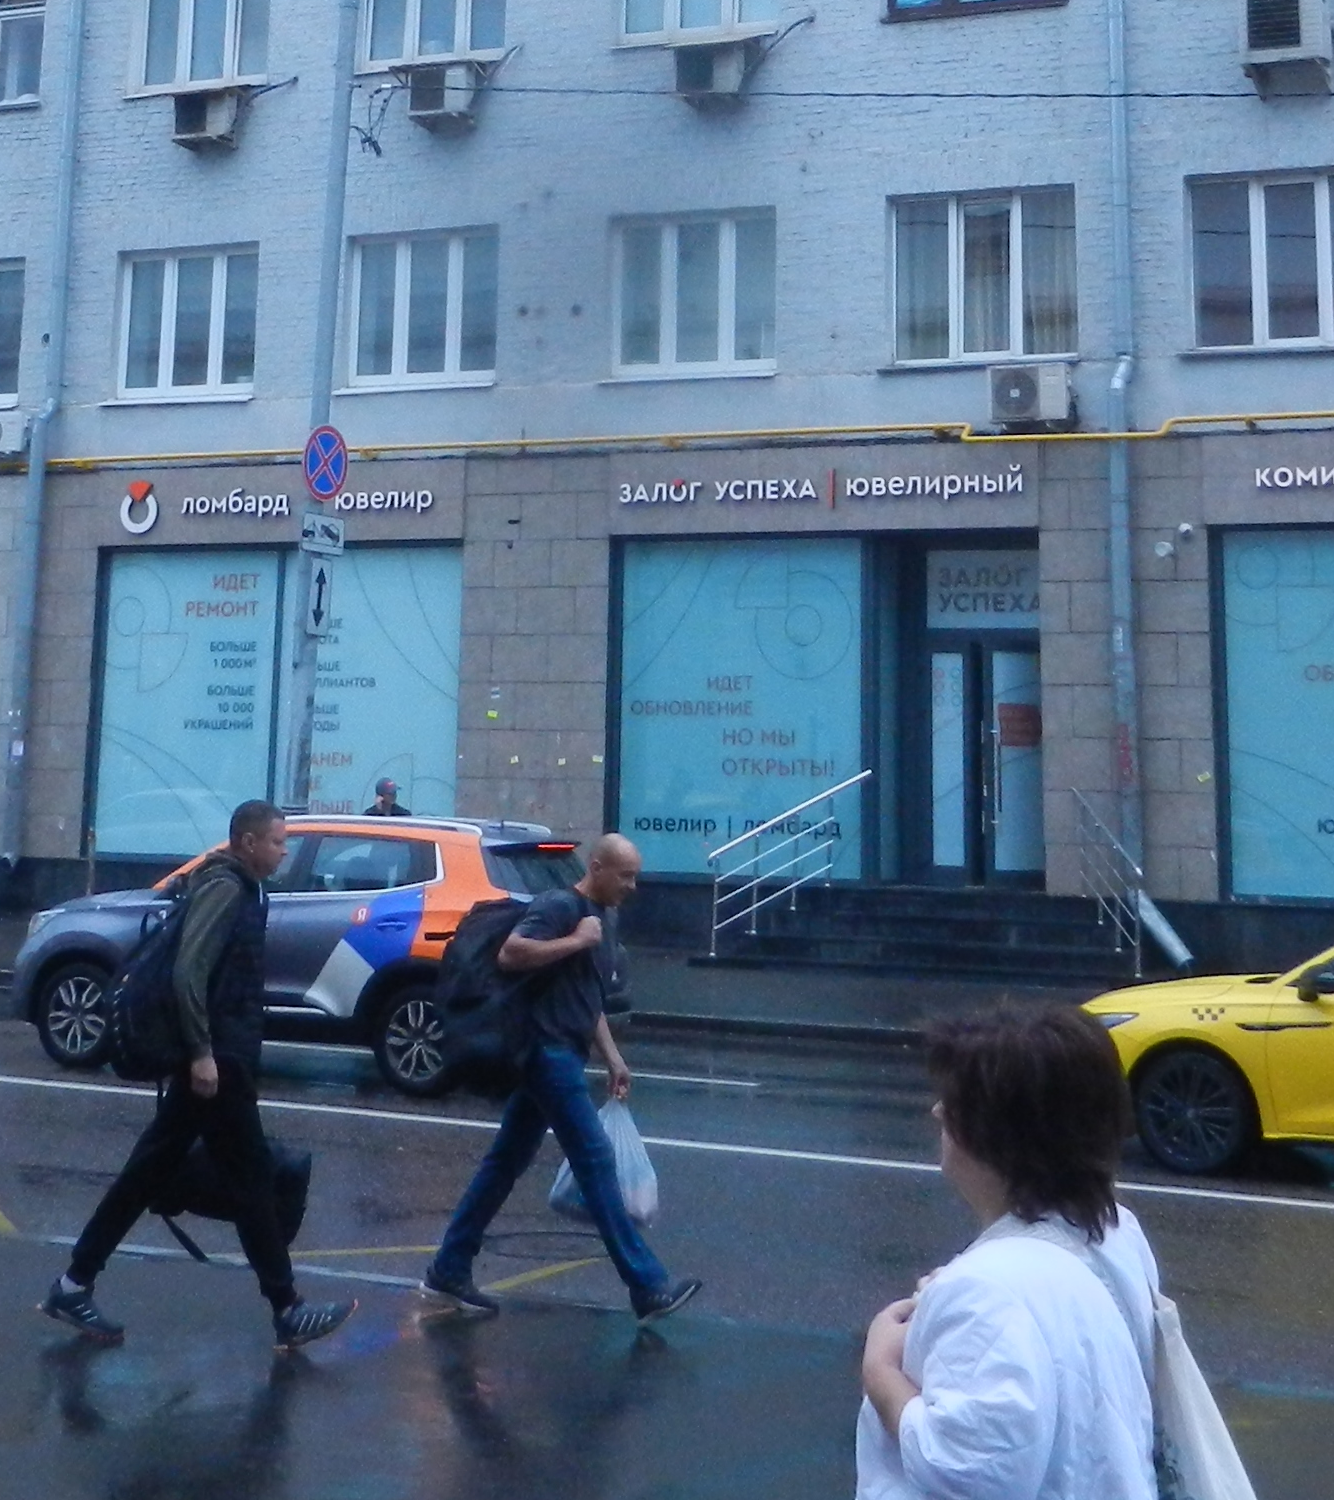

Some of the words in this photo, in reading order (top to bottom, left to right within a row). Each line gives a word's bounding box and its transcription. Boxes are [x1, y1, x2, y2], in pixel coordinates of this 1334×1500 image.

[619, 479, 703, 503] ЗАЛОГ
[714, 478, 817, 501] УСПЕХА
[845, 463, 1024, 499] ювелирный
[181, 487, 290, 516] ломбард
[334, 489, 434, 517] ювелир
[212, 573, 261, 592] ИДЕТ
[938, 564, 1025, 588] ЗАЛОГ
[185, 600, 260, 618] РЕМОНТ
[938, 592, 1040, 613] УСПЕХА
[209, 641, 258, 653] БОЛЬШЕ
[206, 684, 255, 697] БОЛЬШЕ
[706, 675, 753, 693] ИДЕТ
[217, 702, 229, 714] 10
[232, 702, 255, 714] 000
[630, 700, 753, 716] ОБНОВЛЕНИЕ
[183, 716, 254, 731] УКРАШЕНИЙ
[722, 728, 753, 746] НО
[760, 729, 796, 746] МЫ
[722, 758, 836, 777] ОТКРЫТЫ!
[633, 816, 717, 837] ювелир
